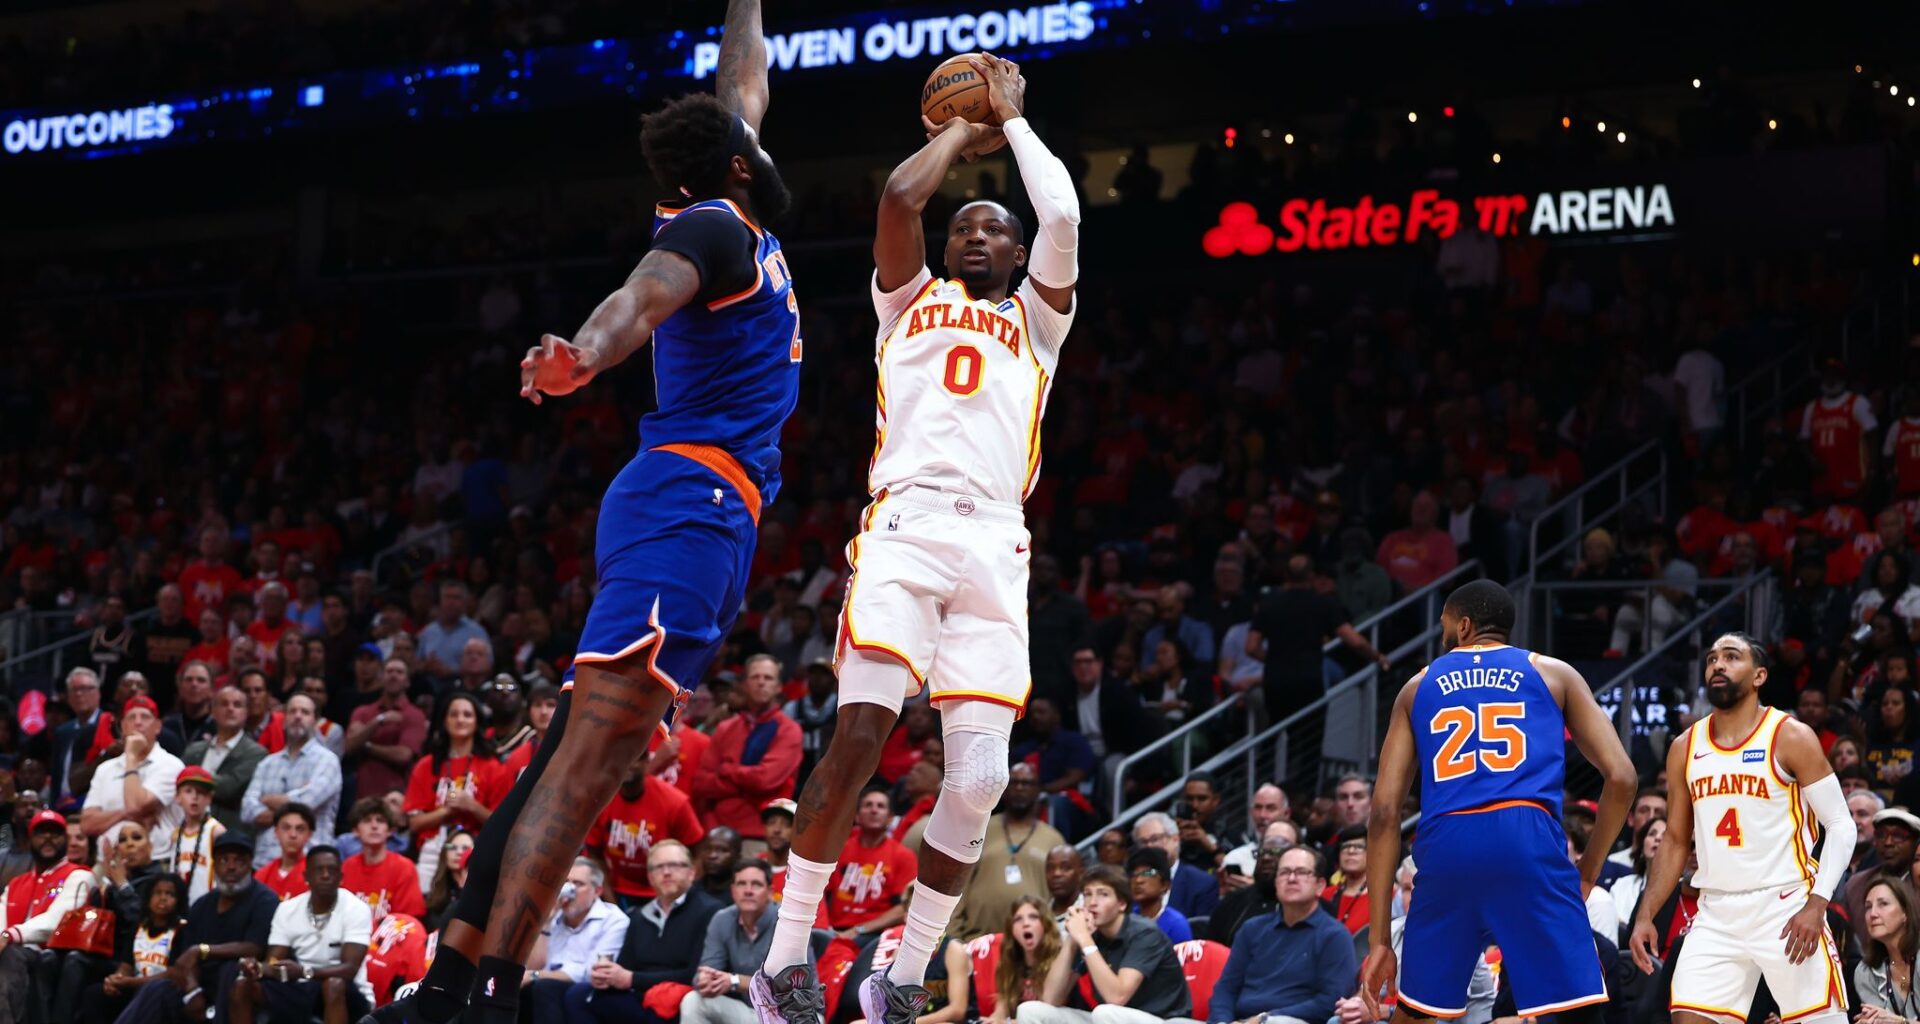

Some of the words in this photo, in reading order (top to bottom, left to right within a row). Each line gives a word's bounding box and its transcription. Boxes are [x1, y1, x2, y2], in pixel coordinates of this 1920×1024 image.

[864, 2, 1095, 62] OUTCOMES
[3, 104, 174, 154] OUTCOMES
[1276, 195, 1400, 253] State
[1404, 189, 1528, 243] Fam
[1529, 185, 1675, 236] ARENA
[906, 303, 1020, 359] ATLANTA
[943, 344, 984, 396] 0
[1436, 668, 1524, 695] BRIDGES
[1430, 702, 1526, 783] 25
[1743, 751, 1765, 761] paze
[1716, 808, 1742, 848] 4
